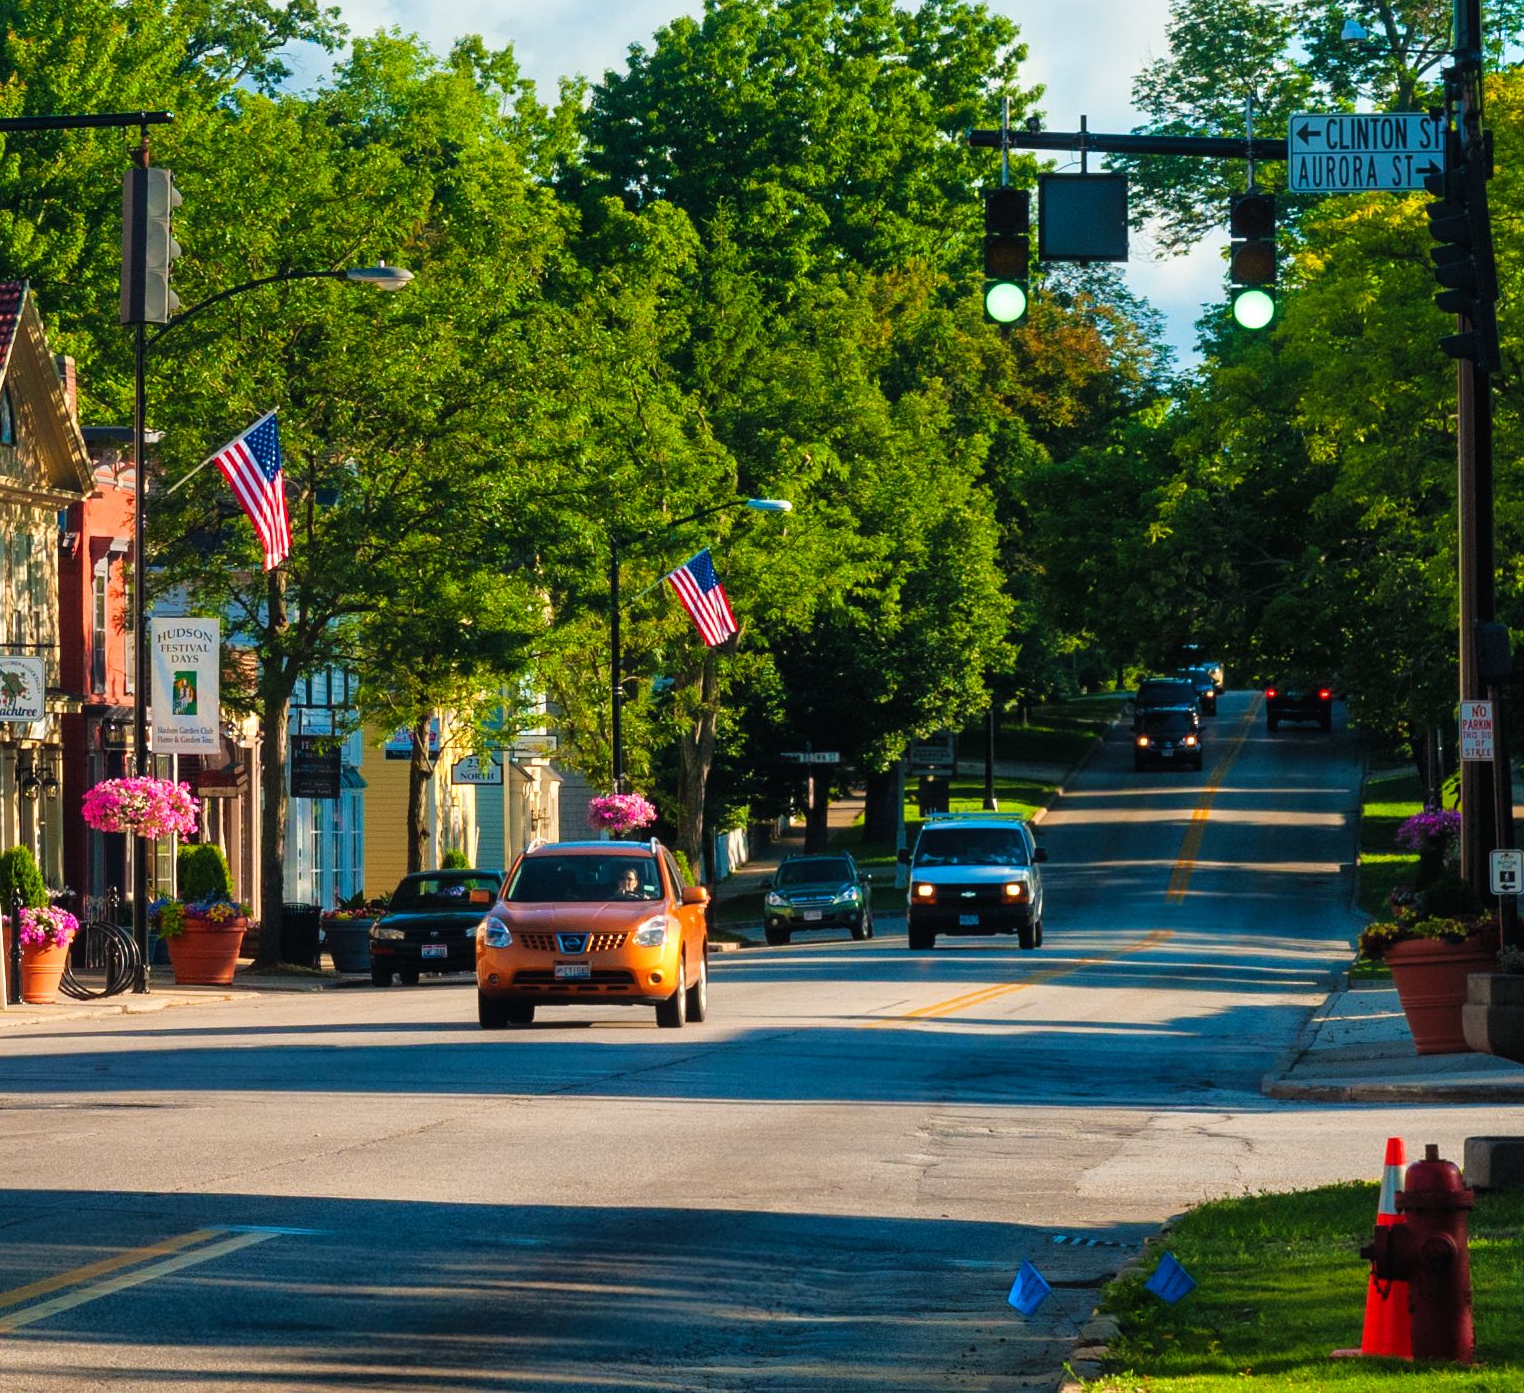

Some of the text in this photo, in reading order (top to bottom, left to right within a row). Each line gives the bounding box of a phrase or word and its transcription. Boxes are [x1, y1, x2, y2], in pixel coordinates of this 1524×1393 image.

[1325, 118, 1442, 151] CLINTON ST
[1297, 155, 1414, 188] AURORA ST
[157, 628, 213, 644] HUDSON
[160, 643, 210, 653] FESTIVAL
[171, 654, 199, 663] DAYS
[1471, 706, 1487, 718] NO
[1462, 719, 1492, 730] PARKIN
[157, 726, 214, 735] Hudson Garden Club
[1480, 731, 1492, 739] SID
[157, 735, 173, 743] Home
[180, 736, 201, 744] Garden
[1465, 748, 1490, 756] STREE
